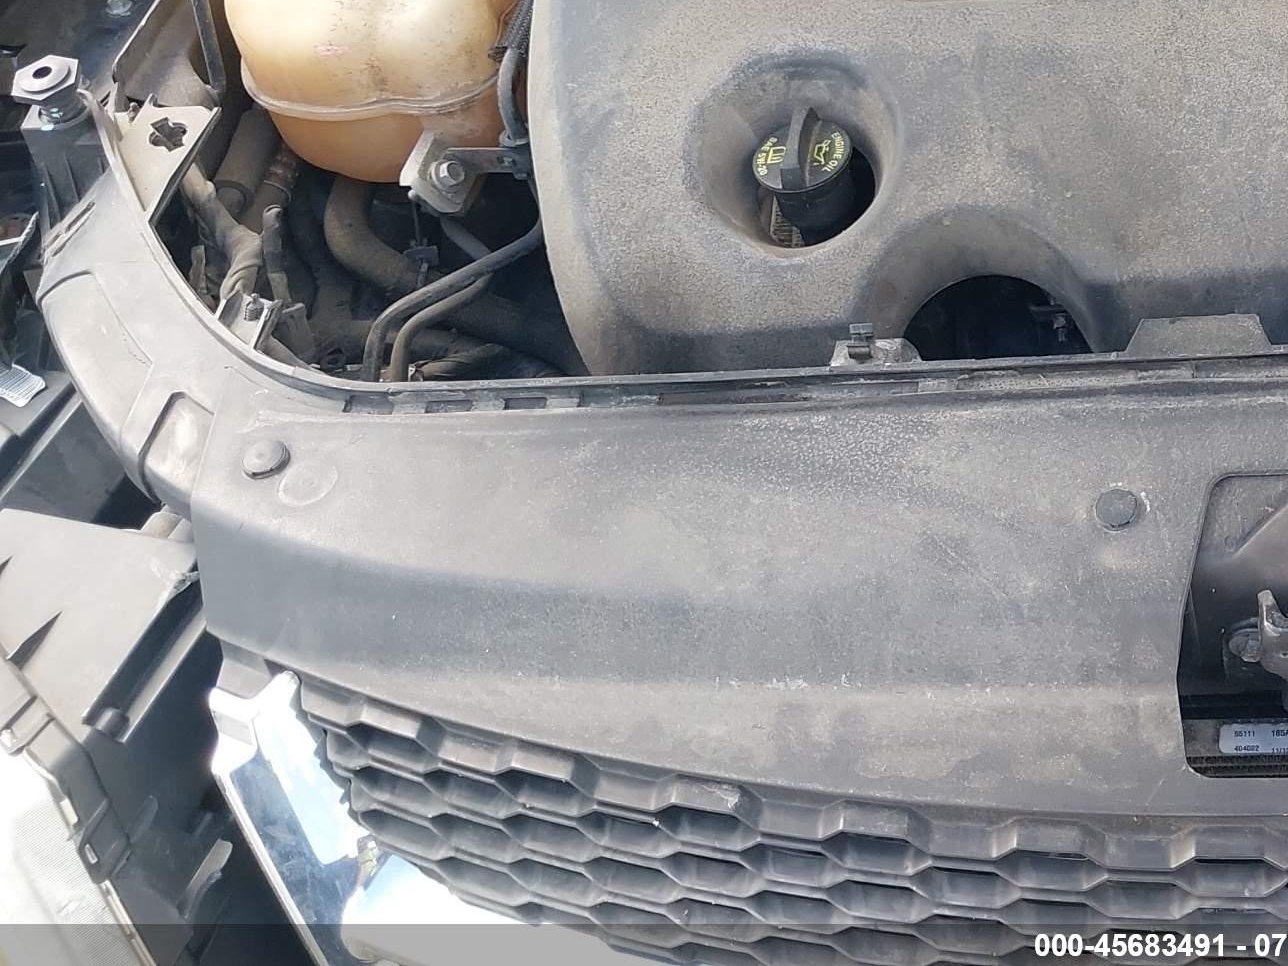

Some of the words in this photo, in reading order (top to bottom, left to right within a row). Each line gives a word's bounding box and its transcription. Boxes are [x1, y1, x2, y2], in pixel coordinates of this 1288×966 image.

[761, 137, 778, 152] SAE
[832, 132, 845, 160] ENGINE
[821, 160, 838, 172] OIL
